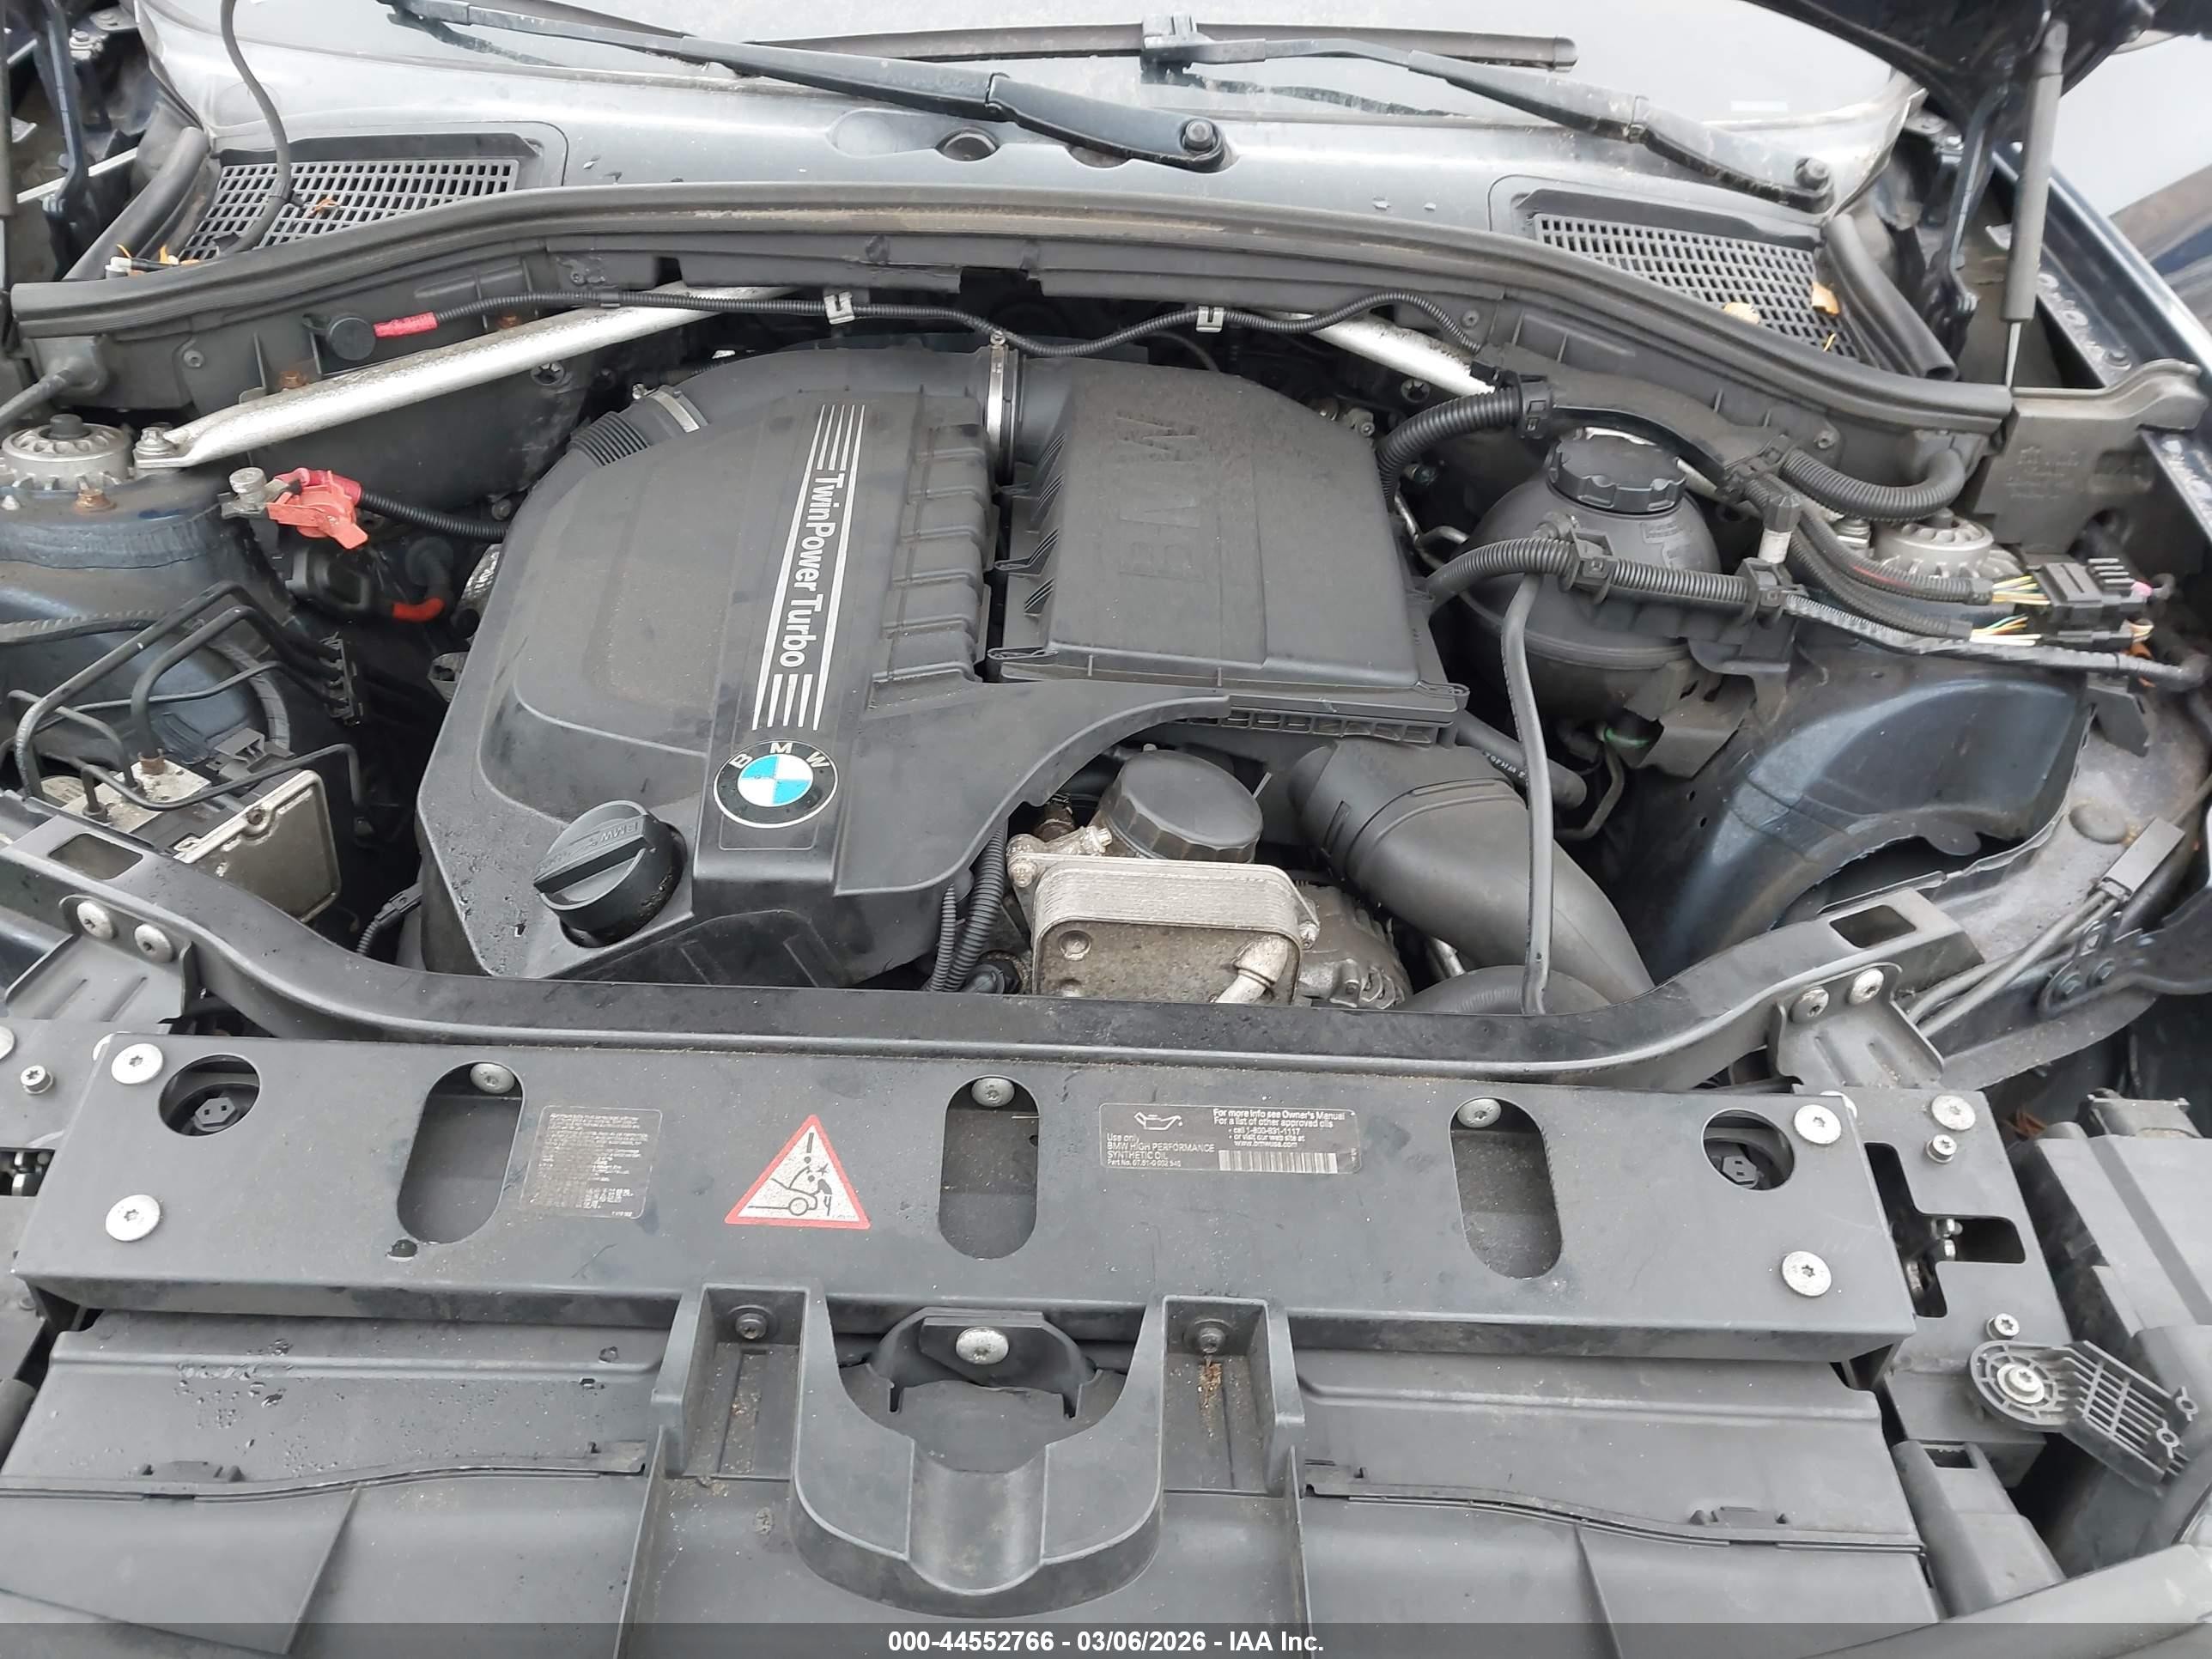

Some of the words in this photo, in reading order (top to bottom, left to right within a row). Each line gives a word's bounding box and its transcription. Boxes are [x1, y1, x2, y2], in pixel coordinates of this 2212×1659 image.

[793, 473, 845, 592] TwinPower
[779, 593, 824, 667] Turbo
[728, 742, 830, 769] BMW
[1281, 1109, 1315, 1119] Owner's
[1316, 1111, 1346, 1120] Manual
[1214, 1116, 1227, 1125] For
[1280, 1119, 1318, 1127] approved
[1107, 1133, 1122, 1141] Use
[1107, 1141, 1128, 1150] BMW
[1130, 1142, 1151, 1151] HIGH
[1152, 1142, 1215, 1152] PERFORMANCE
[1107, 1151, 1154, 1159] SYNTHETIC
[1154, 1152, 1169, 1160] OIL
